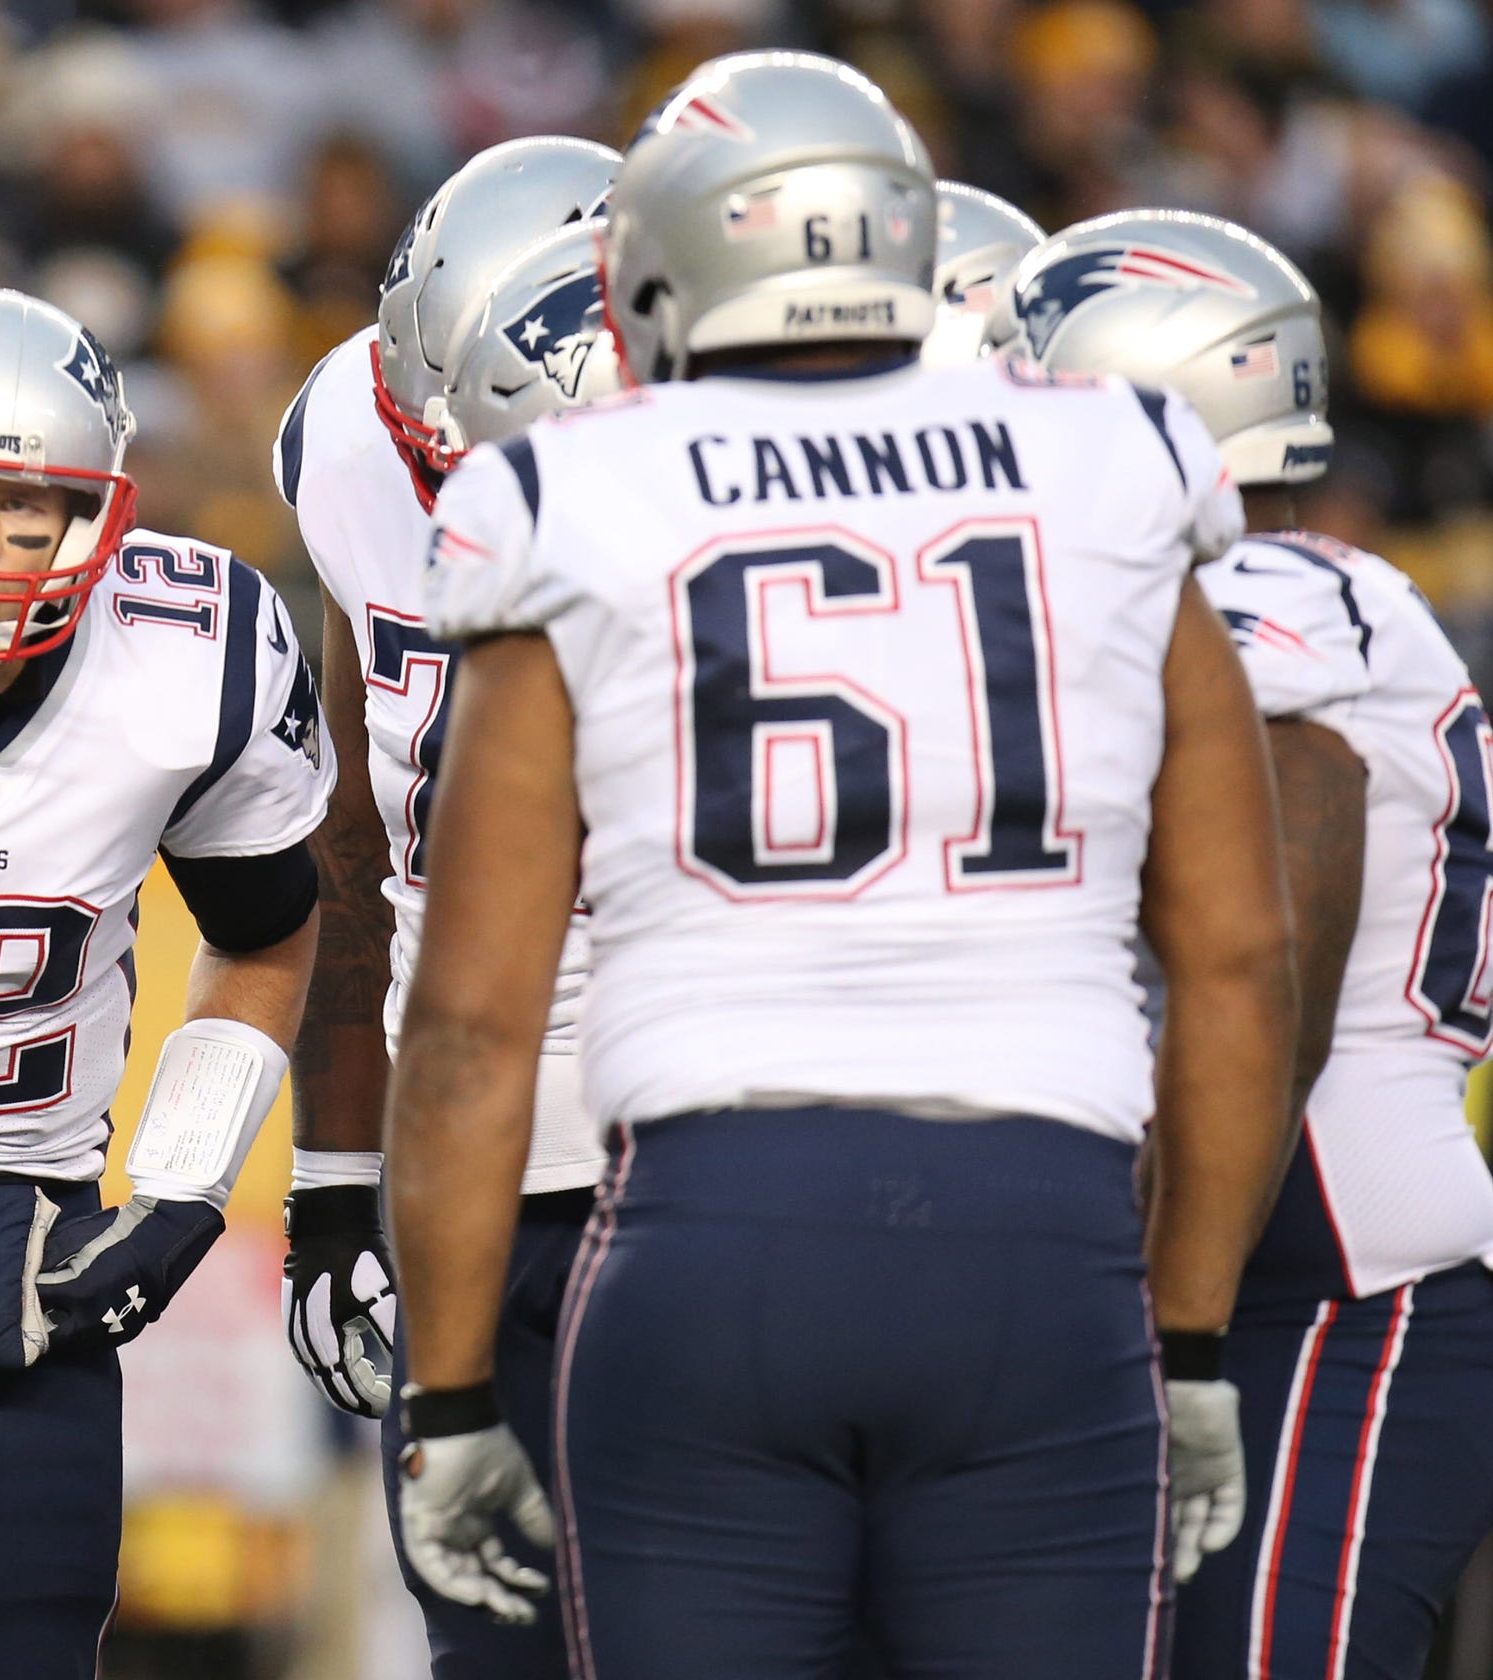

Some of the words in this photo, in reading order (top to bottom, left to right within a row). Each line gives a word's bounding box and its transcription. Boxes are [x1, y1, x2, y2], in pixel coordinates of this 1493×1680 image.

[806, 213, 870, 263] 61
[688, 420, 1029, 506] CANNON
[113, 542, 221, 641] 12
[668, 515, 1085, 902] 61
